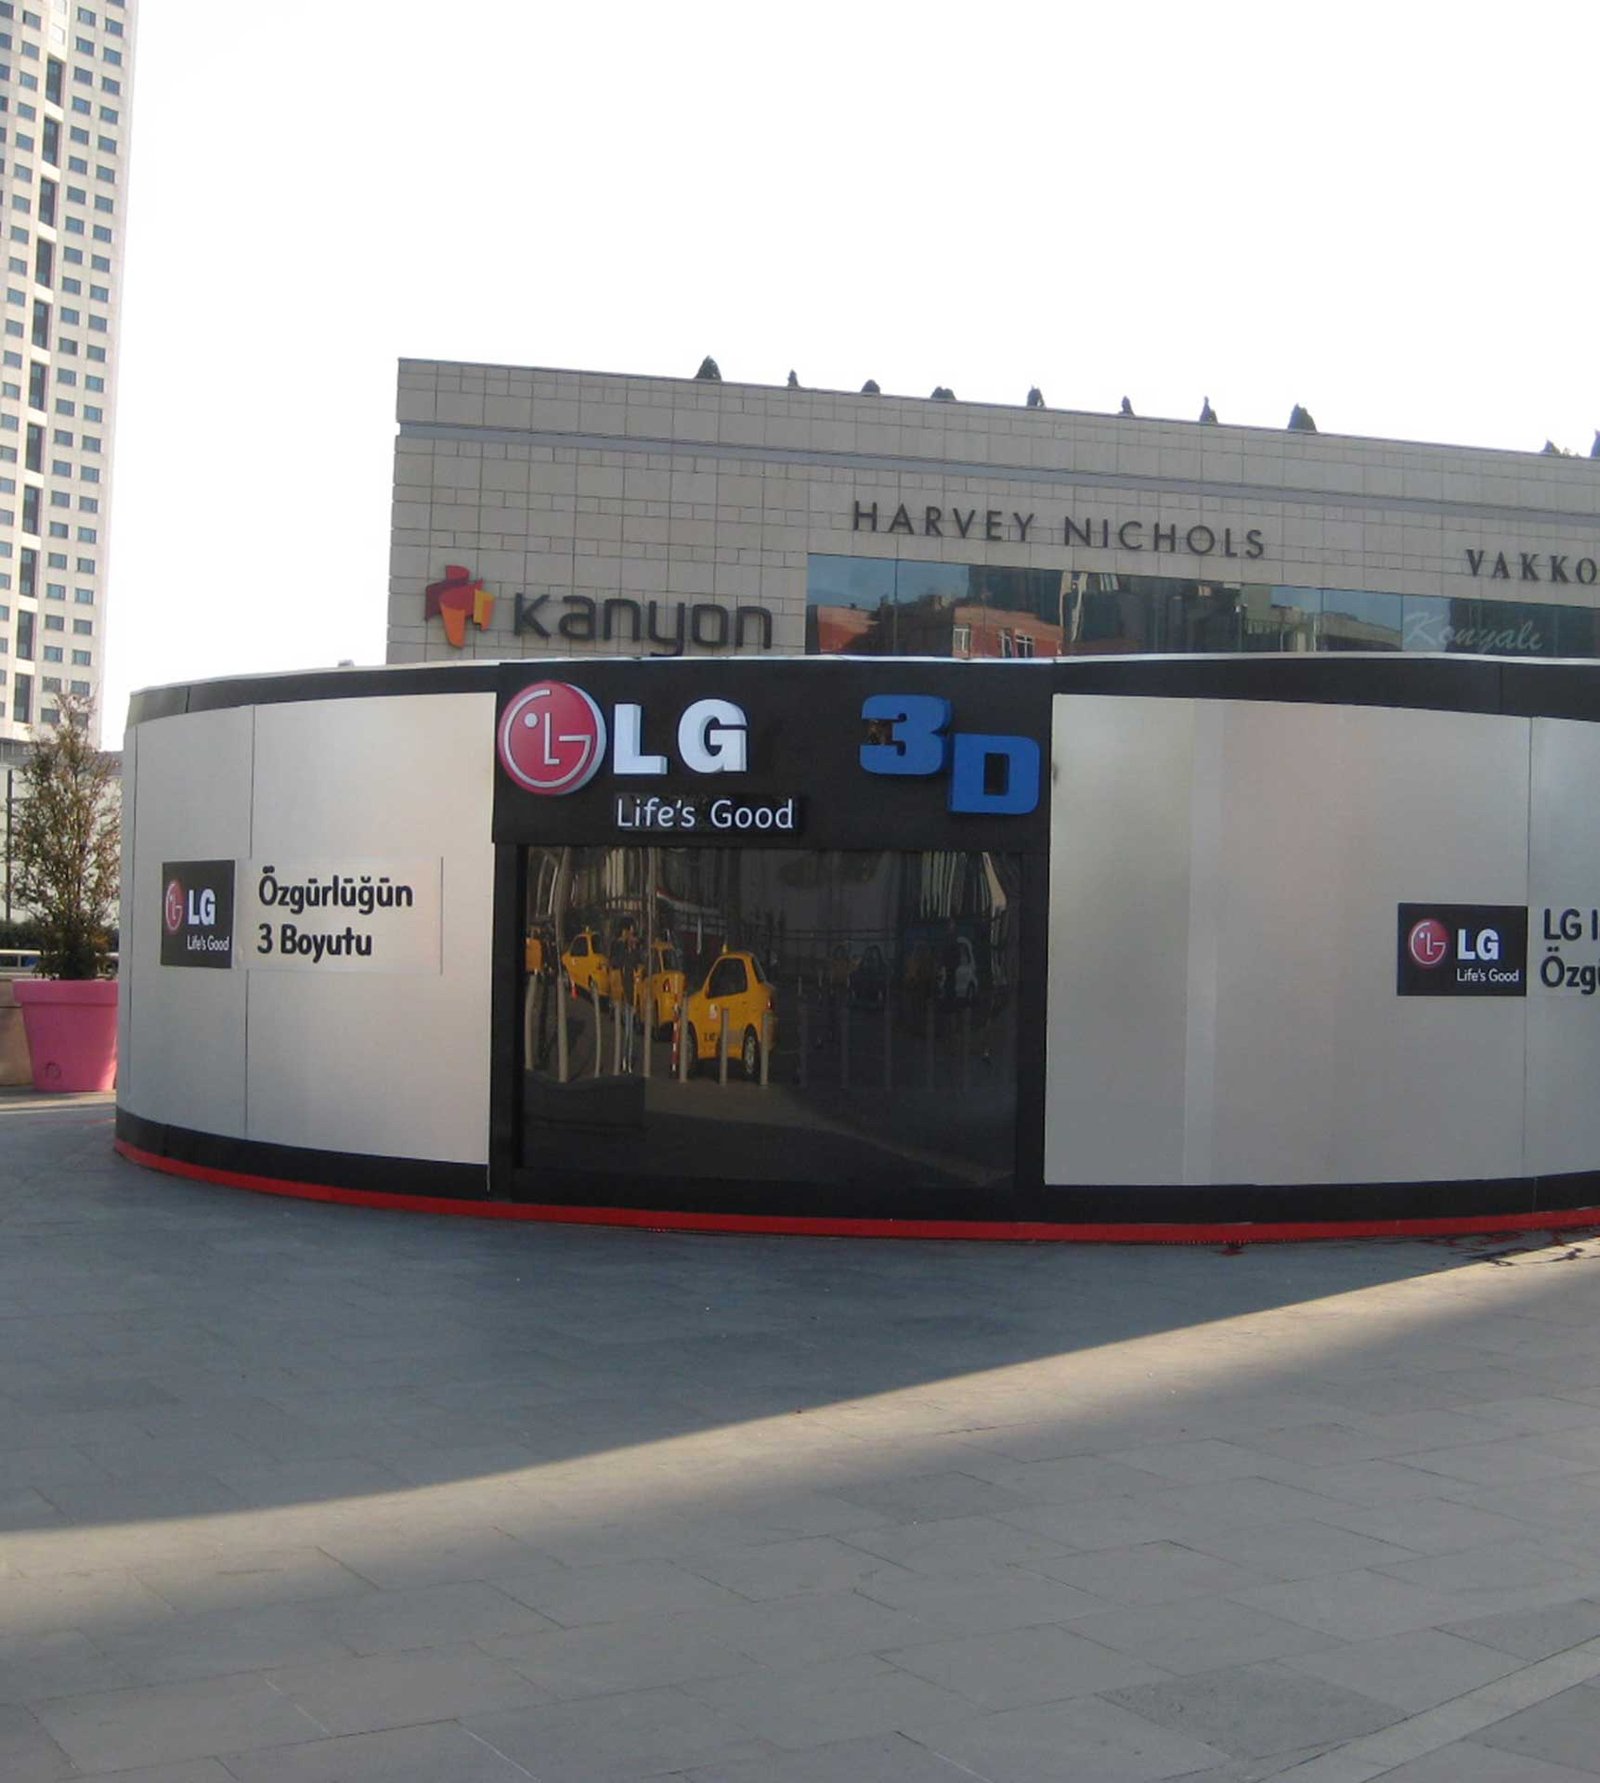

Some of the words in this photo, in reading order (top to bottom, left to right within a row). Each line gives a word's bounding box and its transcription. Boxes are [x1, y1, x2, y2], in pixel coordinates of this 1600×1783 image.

[853, 500, 1035, 542] HARVEY
[1064, 516, 1265, 559] NICHOLS
[1466, 549, 1598, 585] VAKKO
[613, 699, 748, 775] LG
[859, 694, 1041, 816] 3D
[617, 797, 696, 829] Life's
[710, 798, 794, 830] Good
[188, 888, 216, 926] LG
[259, 865, 413, 915] Özgürlüğün
[207, 935, 231, 951] Good
[1544, 908, 1582, 941] LG
[257, 924, 273, 954] 3
[280, 924, 372, 964] Boyutu
[1457, 928, 1500, 961] LG
[1456, 967, 1487, 982] Life's
[1489, 967, 1520, 982] Good
[1540, 946, 1600, 995] Özg
